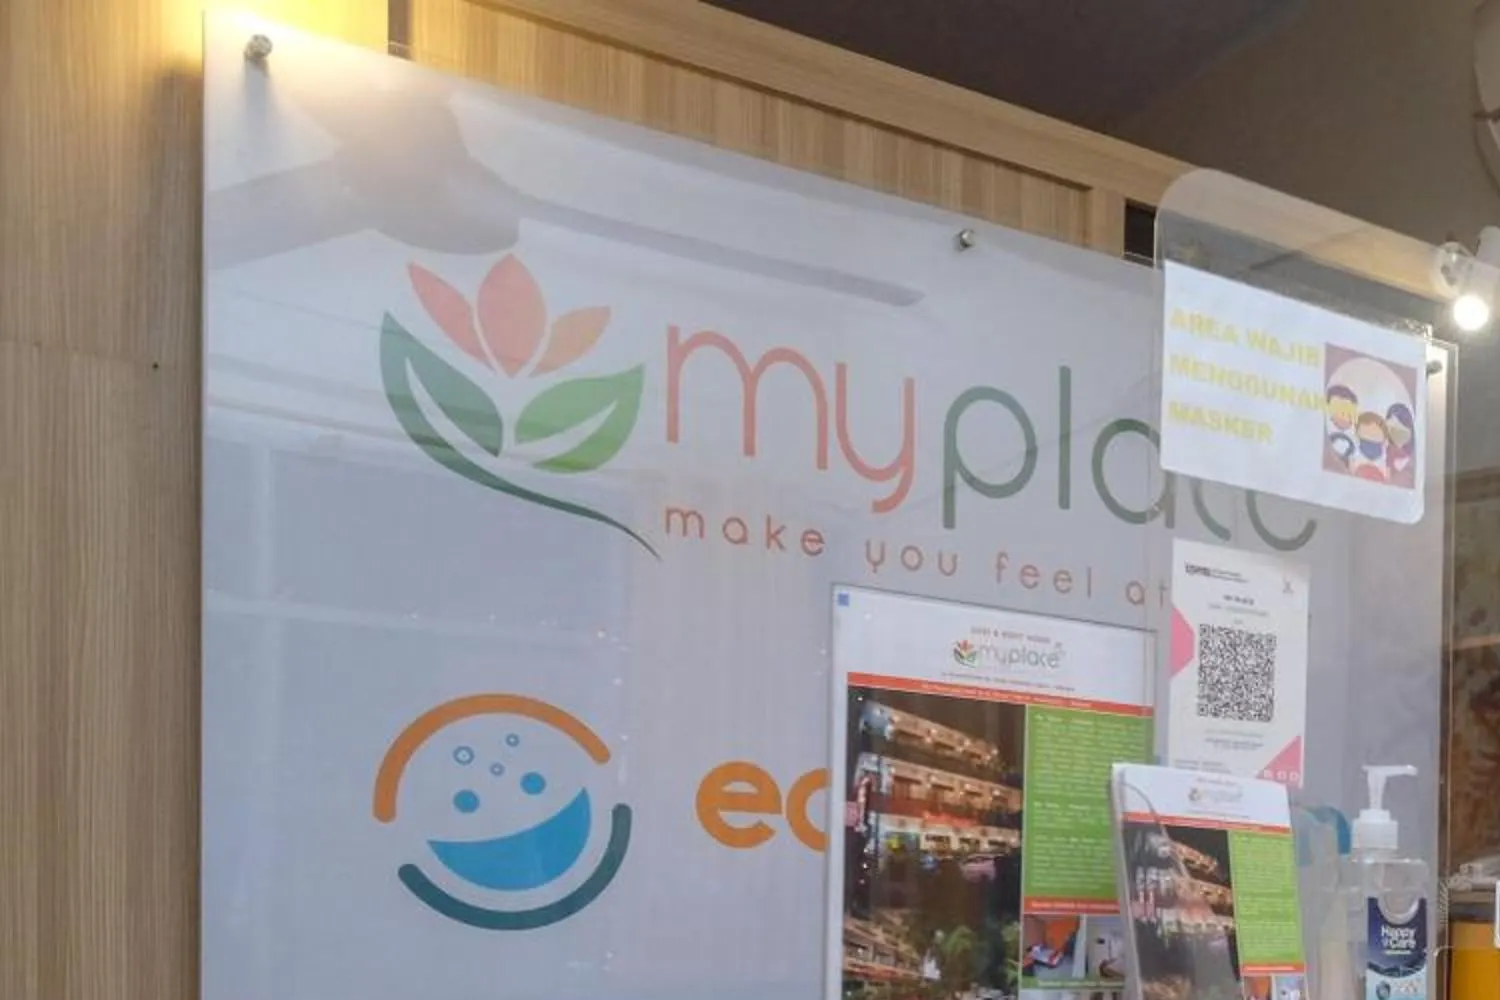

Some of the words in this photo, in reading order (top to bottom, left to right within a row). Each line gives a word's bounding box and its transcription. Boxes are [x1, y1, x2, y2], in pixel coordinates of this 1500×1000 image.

[1168, 400, 1274, 444] MASKER
[665, 505, 825, 559] make
[865, 538, 958, 577] you
[995, 551, 1092, 598] feel
